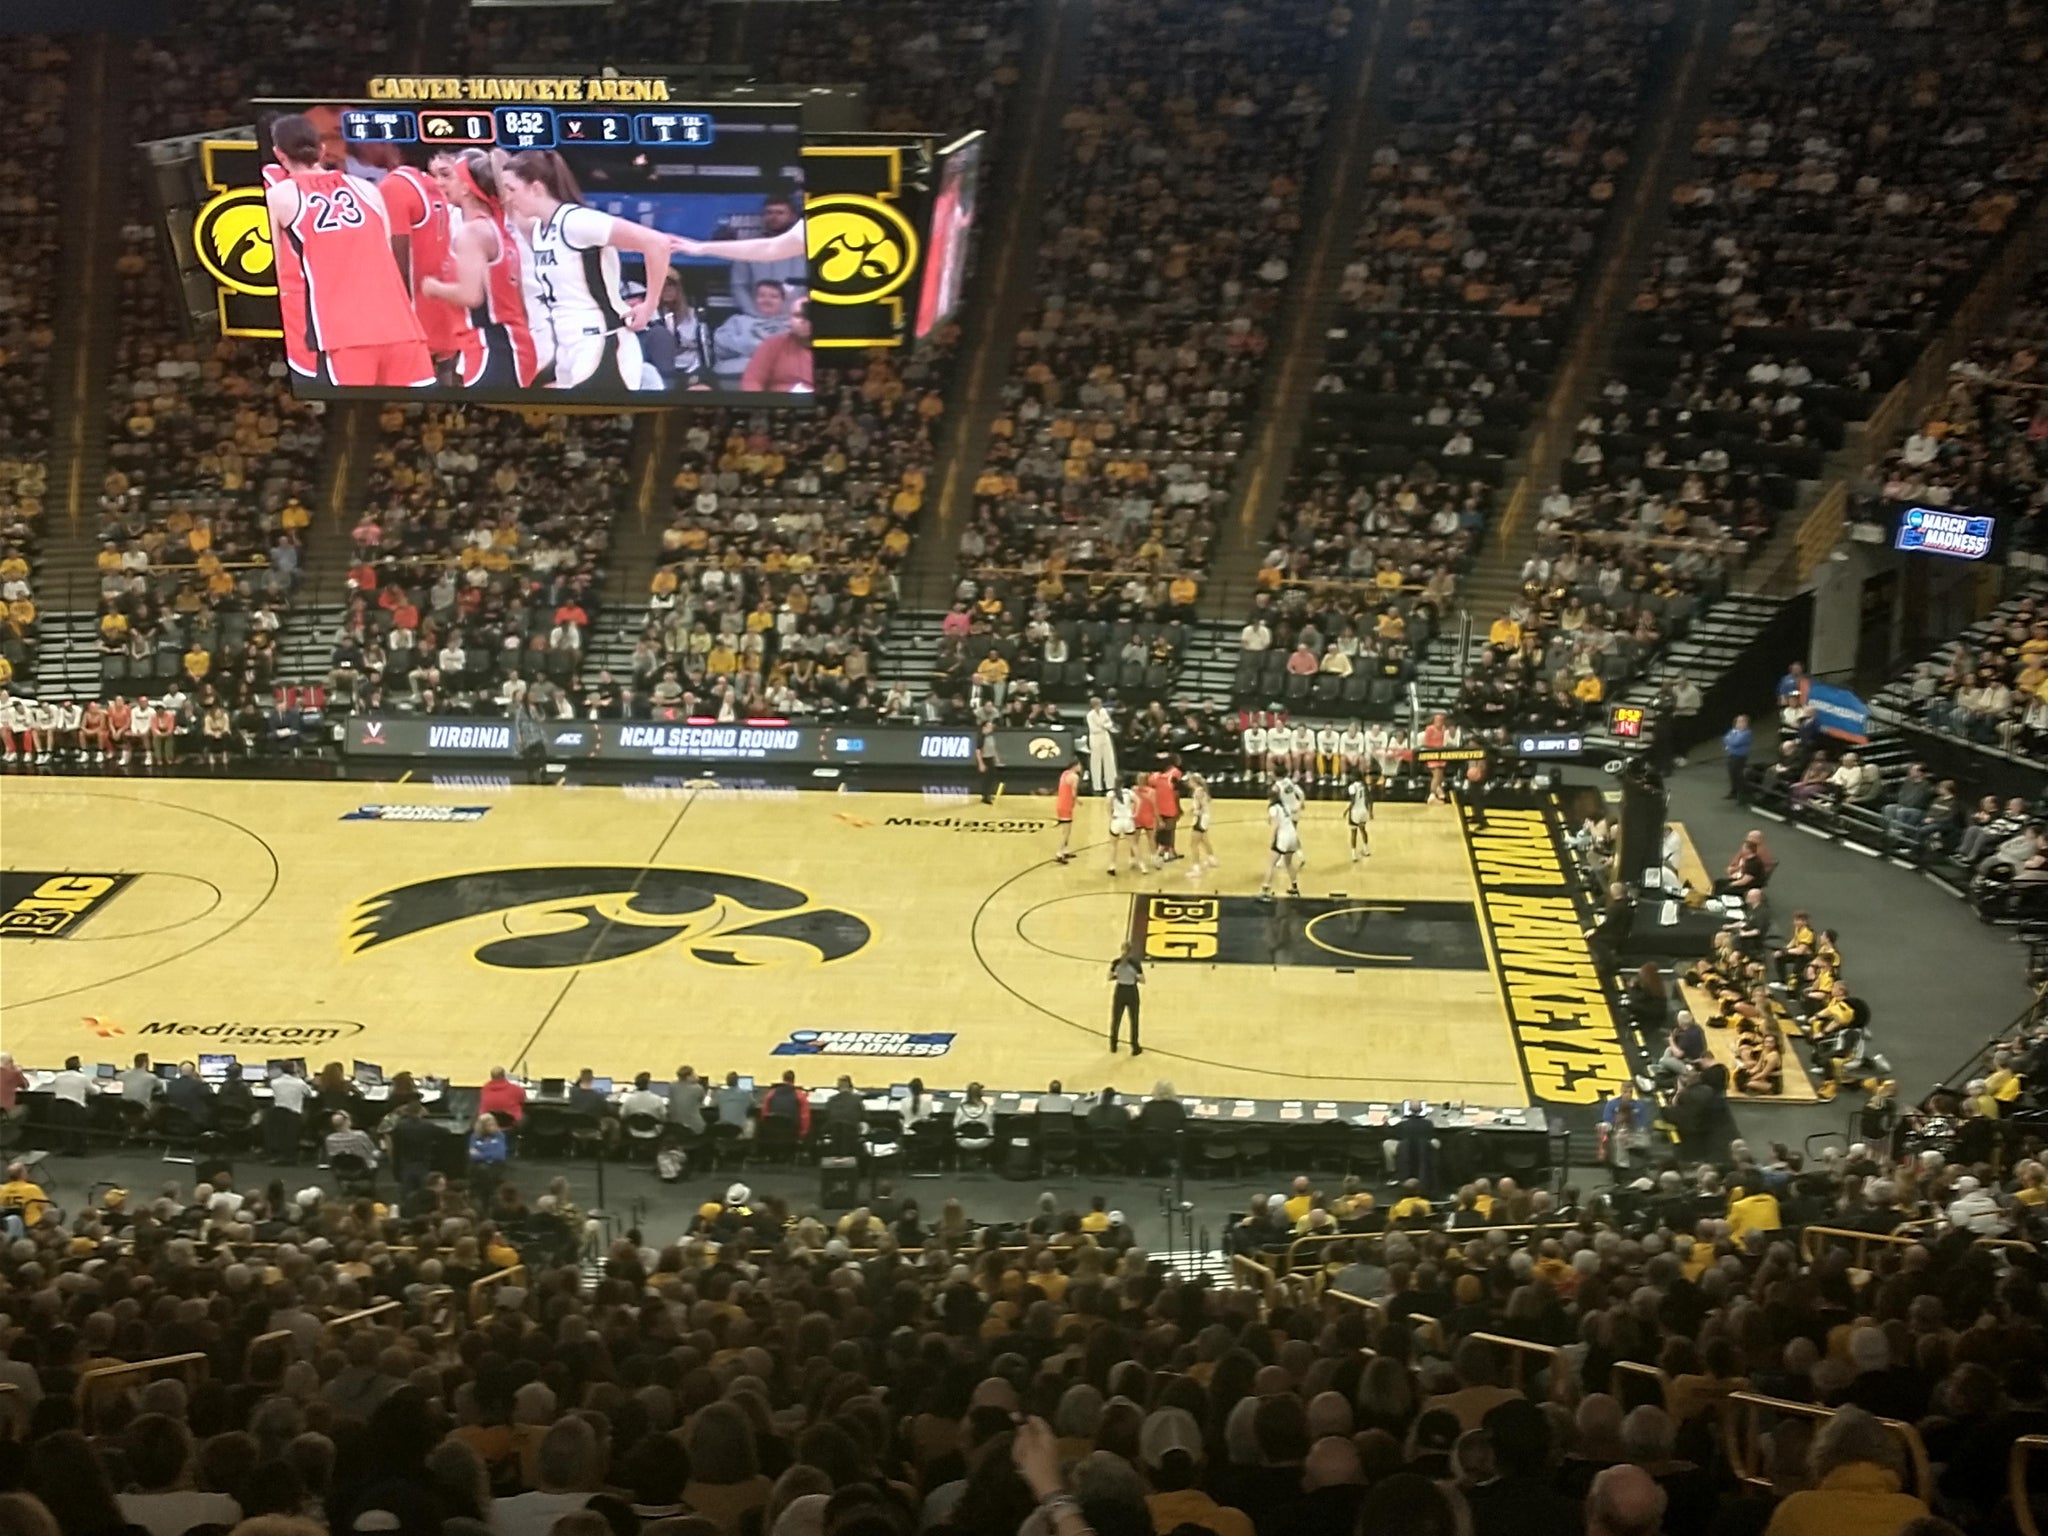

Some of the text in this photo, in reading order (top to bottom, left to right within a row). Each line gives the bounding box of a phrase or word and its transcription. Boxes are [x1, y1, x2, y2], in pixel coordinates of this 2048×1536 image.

[368, 78, 670, 101] CARVER-HAWKEYE ARENA
[467, 116, 481, 139] 0
[505, 111, 545, 134] 8:52
[602, 117, 617, 140] 2
[306, 189, 366, 234] 23
[1921, 513, 1967, 534] MARCH
[1924, 529, 1985, 552] MADNESS
[429, 726, 510, 748] VIRGINIA
[619, 726, 800, 750] NCAA SECOND ROUND
[921, 735, 971, 758] IOWA
[884, 817, 1046, 830] Mediacom
[1463, 806, 1640, 1105] IOWA HAWKEYES
[138, 1021, 341, 1040] Mediacom
[816, 1031, 911, 1044] MARCH
[822, 1042, 949, 1055] MADNESS
